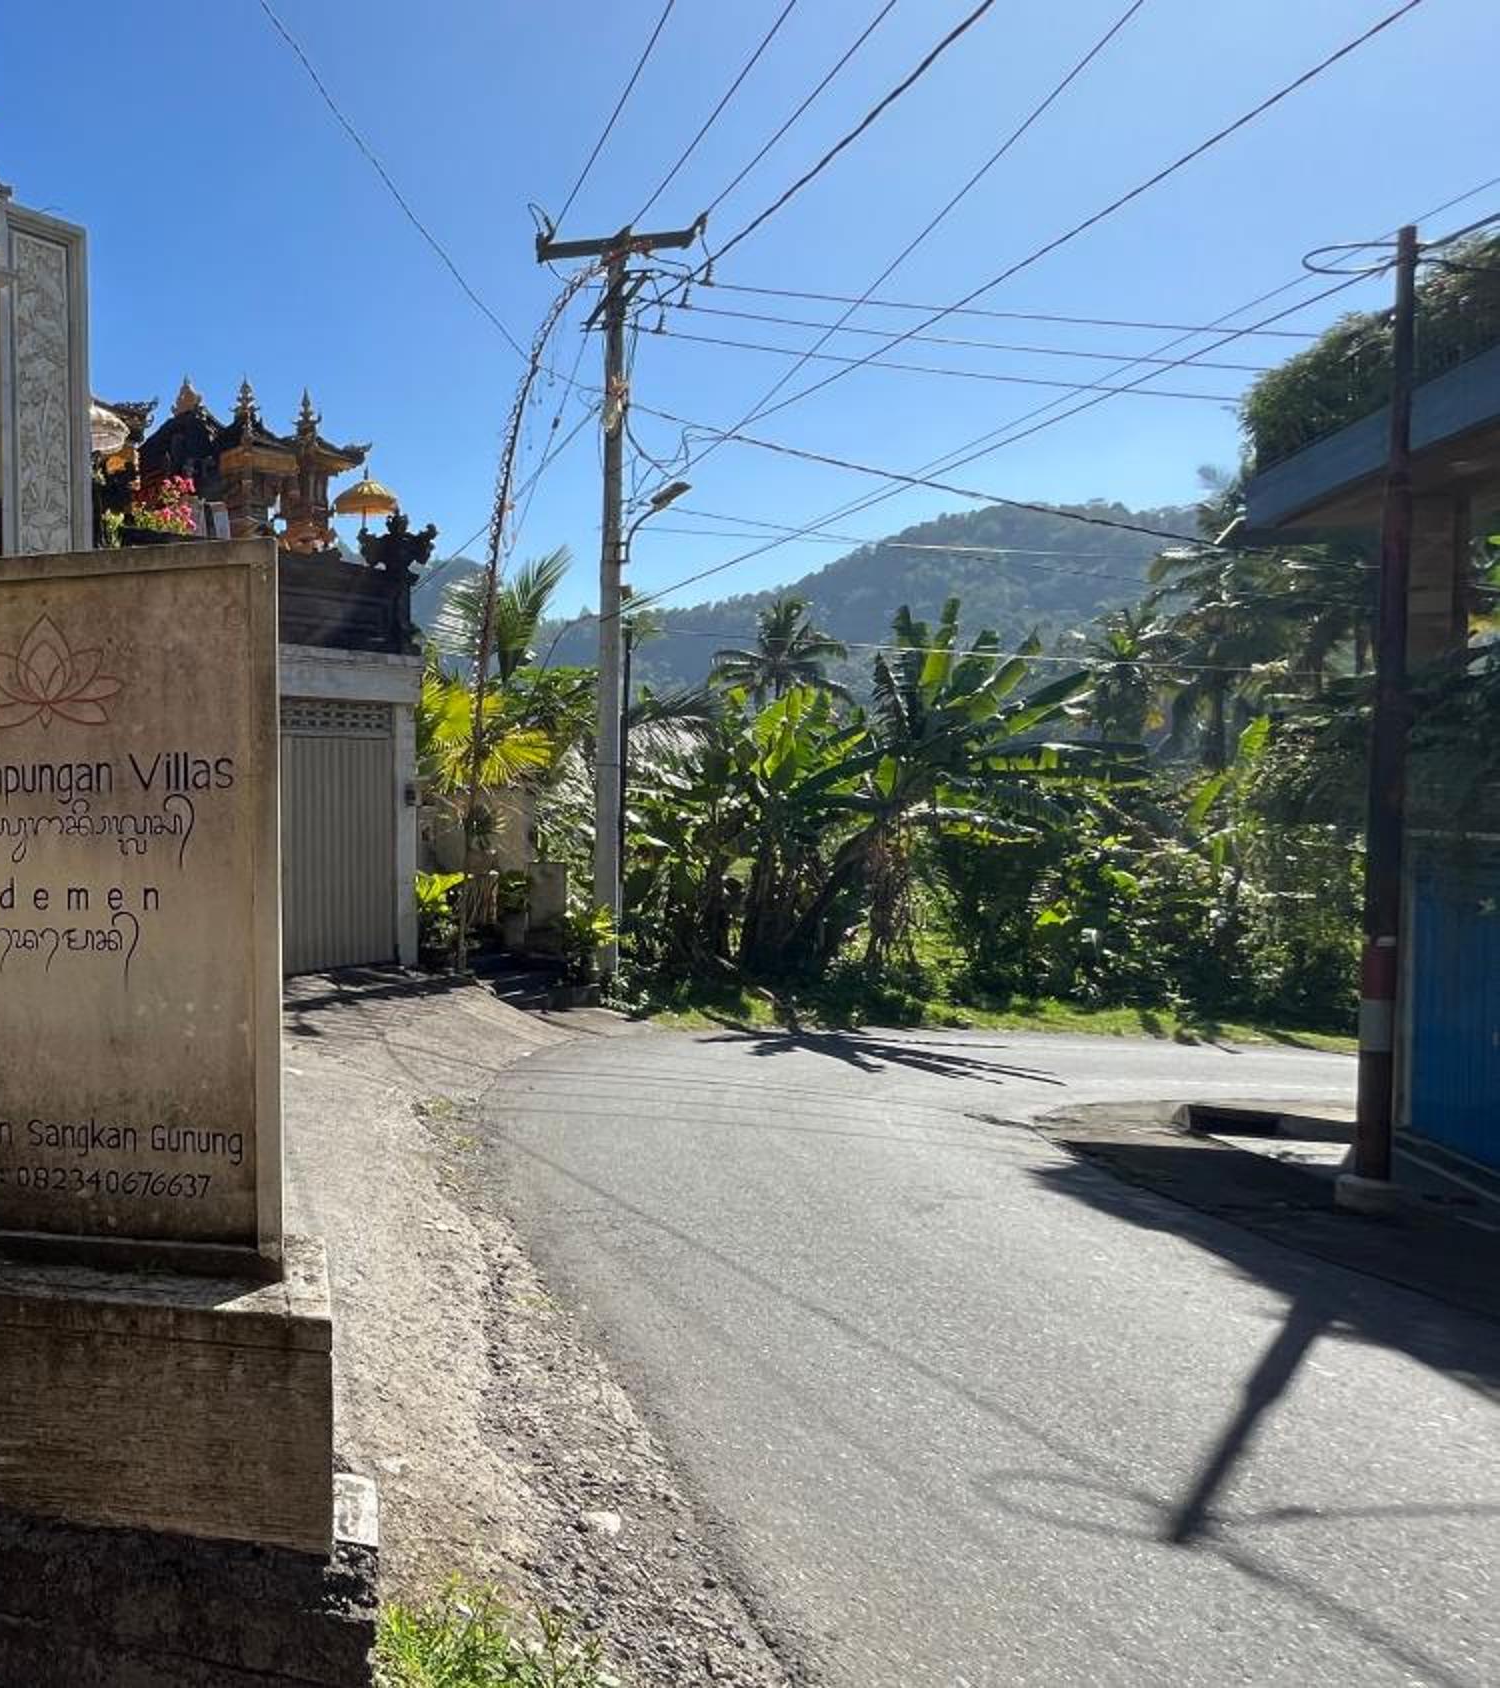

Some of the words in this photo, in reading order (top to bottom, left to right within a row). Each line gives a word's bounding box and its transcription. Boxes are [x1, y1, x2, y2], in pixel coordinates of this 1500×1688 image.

[128, 751, 235, 794] Villas
[27, 1119, 137, 1157] Sangkan
[150, 1124, 244, 1167] Gunung
[17, 1167, 212, 1199] 082340676637
